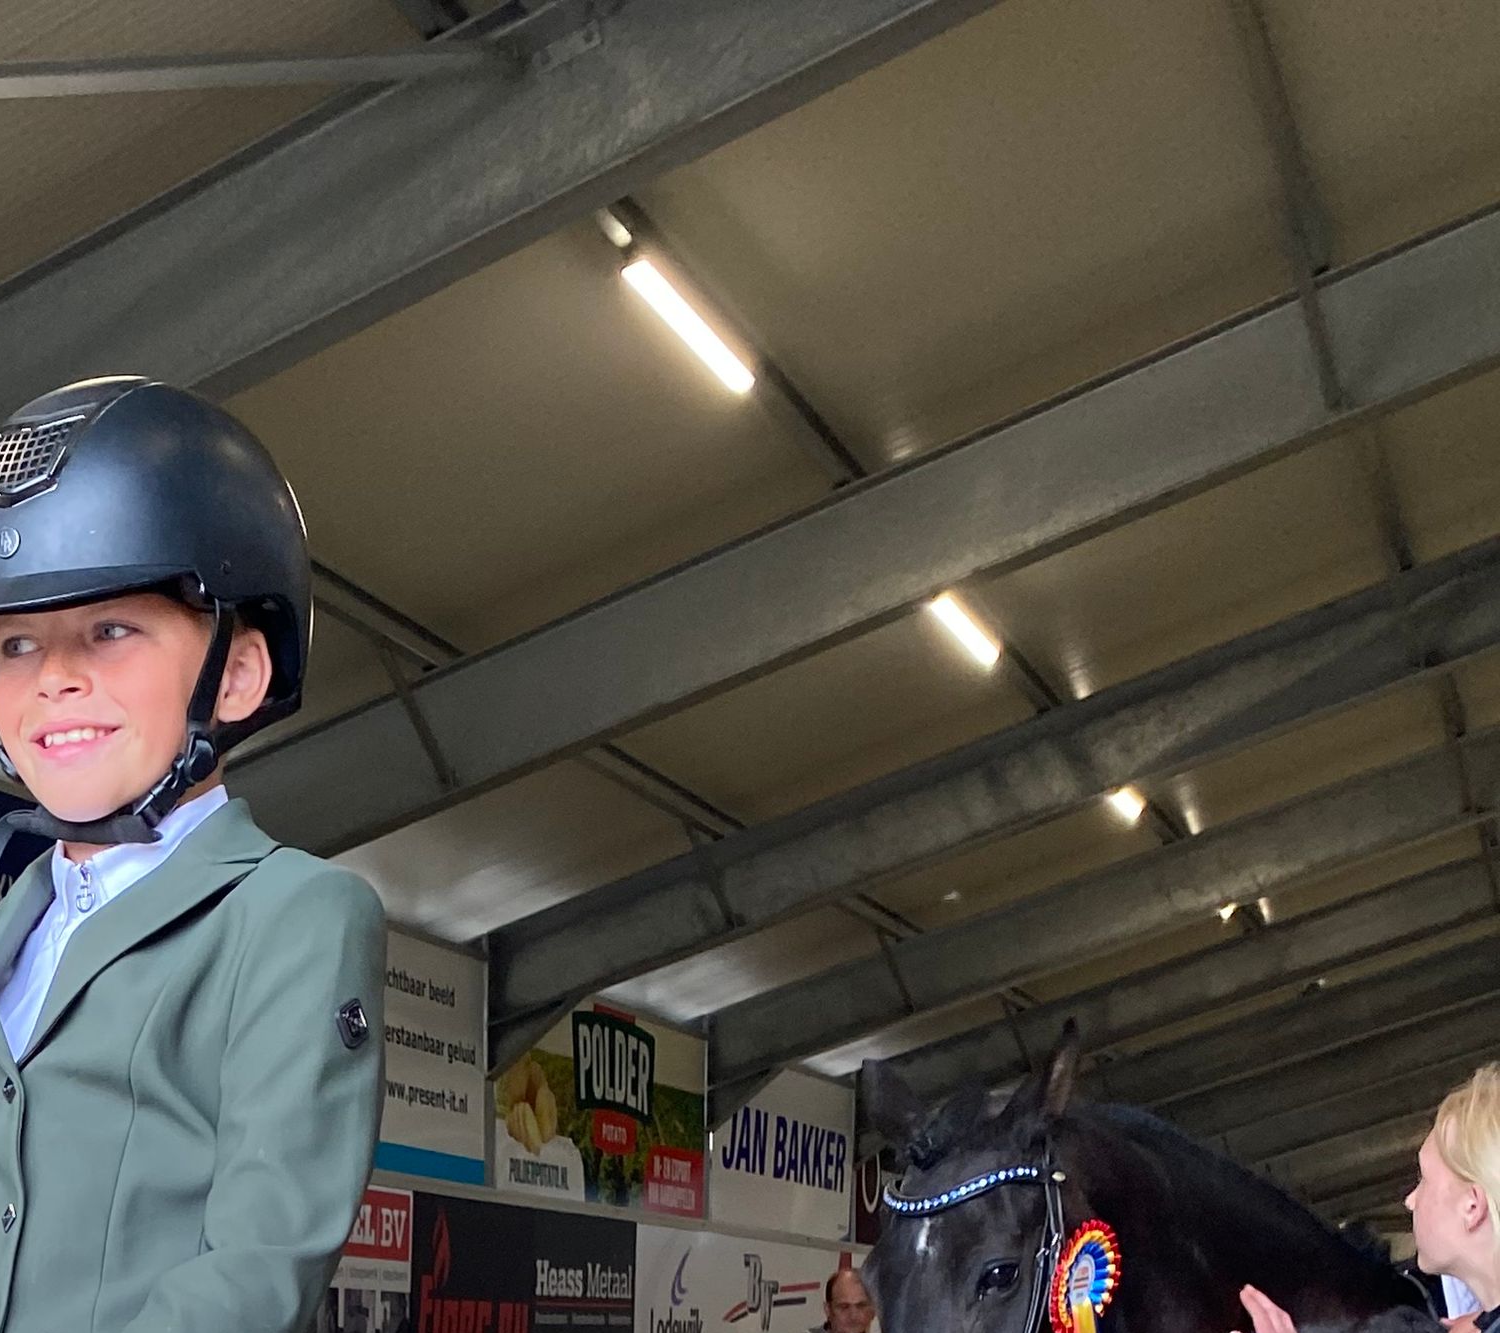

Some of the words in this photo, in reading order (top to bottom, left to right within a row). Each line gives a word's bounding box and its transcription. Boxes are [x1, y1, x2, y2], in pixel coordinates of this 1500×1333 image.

[385, 967, 426, 997] chtbaar
[429, 979, 456, 1008] beeld
[385, 1025, 445, 1057] erstaanbaar
[448, 1041, 477, 1065] geluid
[578, 1024, 650, 1115] POLDER
[386, 1080, 469, 1115] ww.present-it.nl
[722, 1106, 768, 1176] JAN
[773, 1115, 847, 1193] BAKKER
[348, 1204, 376, 1246] EL
[381, 1208, 407, 1249] BV
[535, 1259, 583, 1297] Heass
[587, 1262, 632, 1299] Metaal
